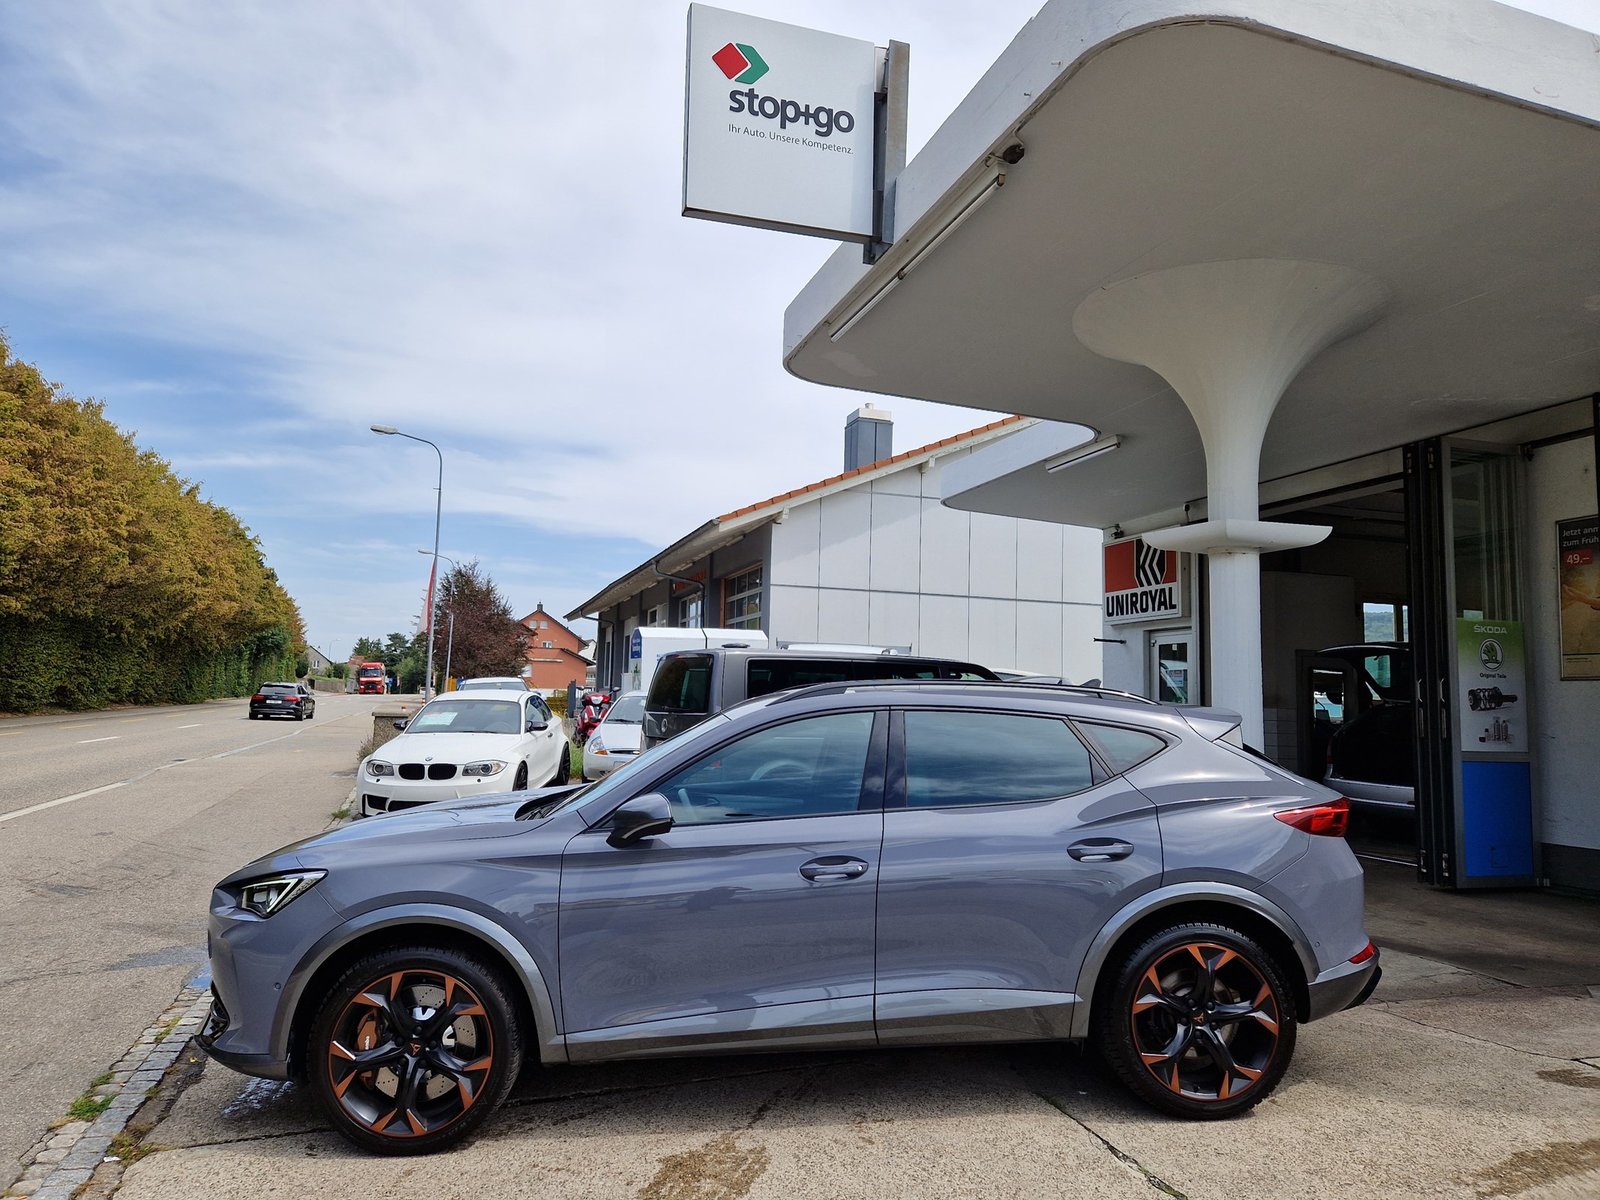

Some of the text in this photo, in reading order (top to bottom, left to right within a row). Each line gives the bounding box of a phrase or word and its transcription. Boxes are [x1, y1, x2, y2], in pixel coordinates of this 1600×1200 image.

[729, 88, 855, 137] stop+go
[728, 124, 854, 155] Ihr Auto. Unsere Kompetenz.
[1563, 528, 1581, 537] Jetzt
[1563, 539, 1580, 547] zum
[1106, 586, 1177, 617] UNIROYAL
